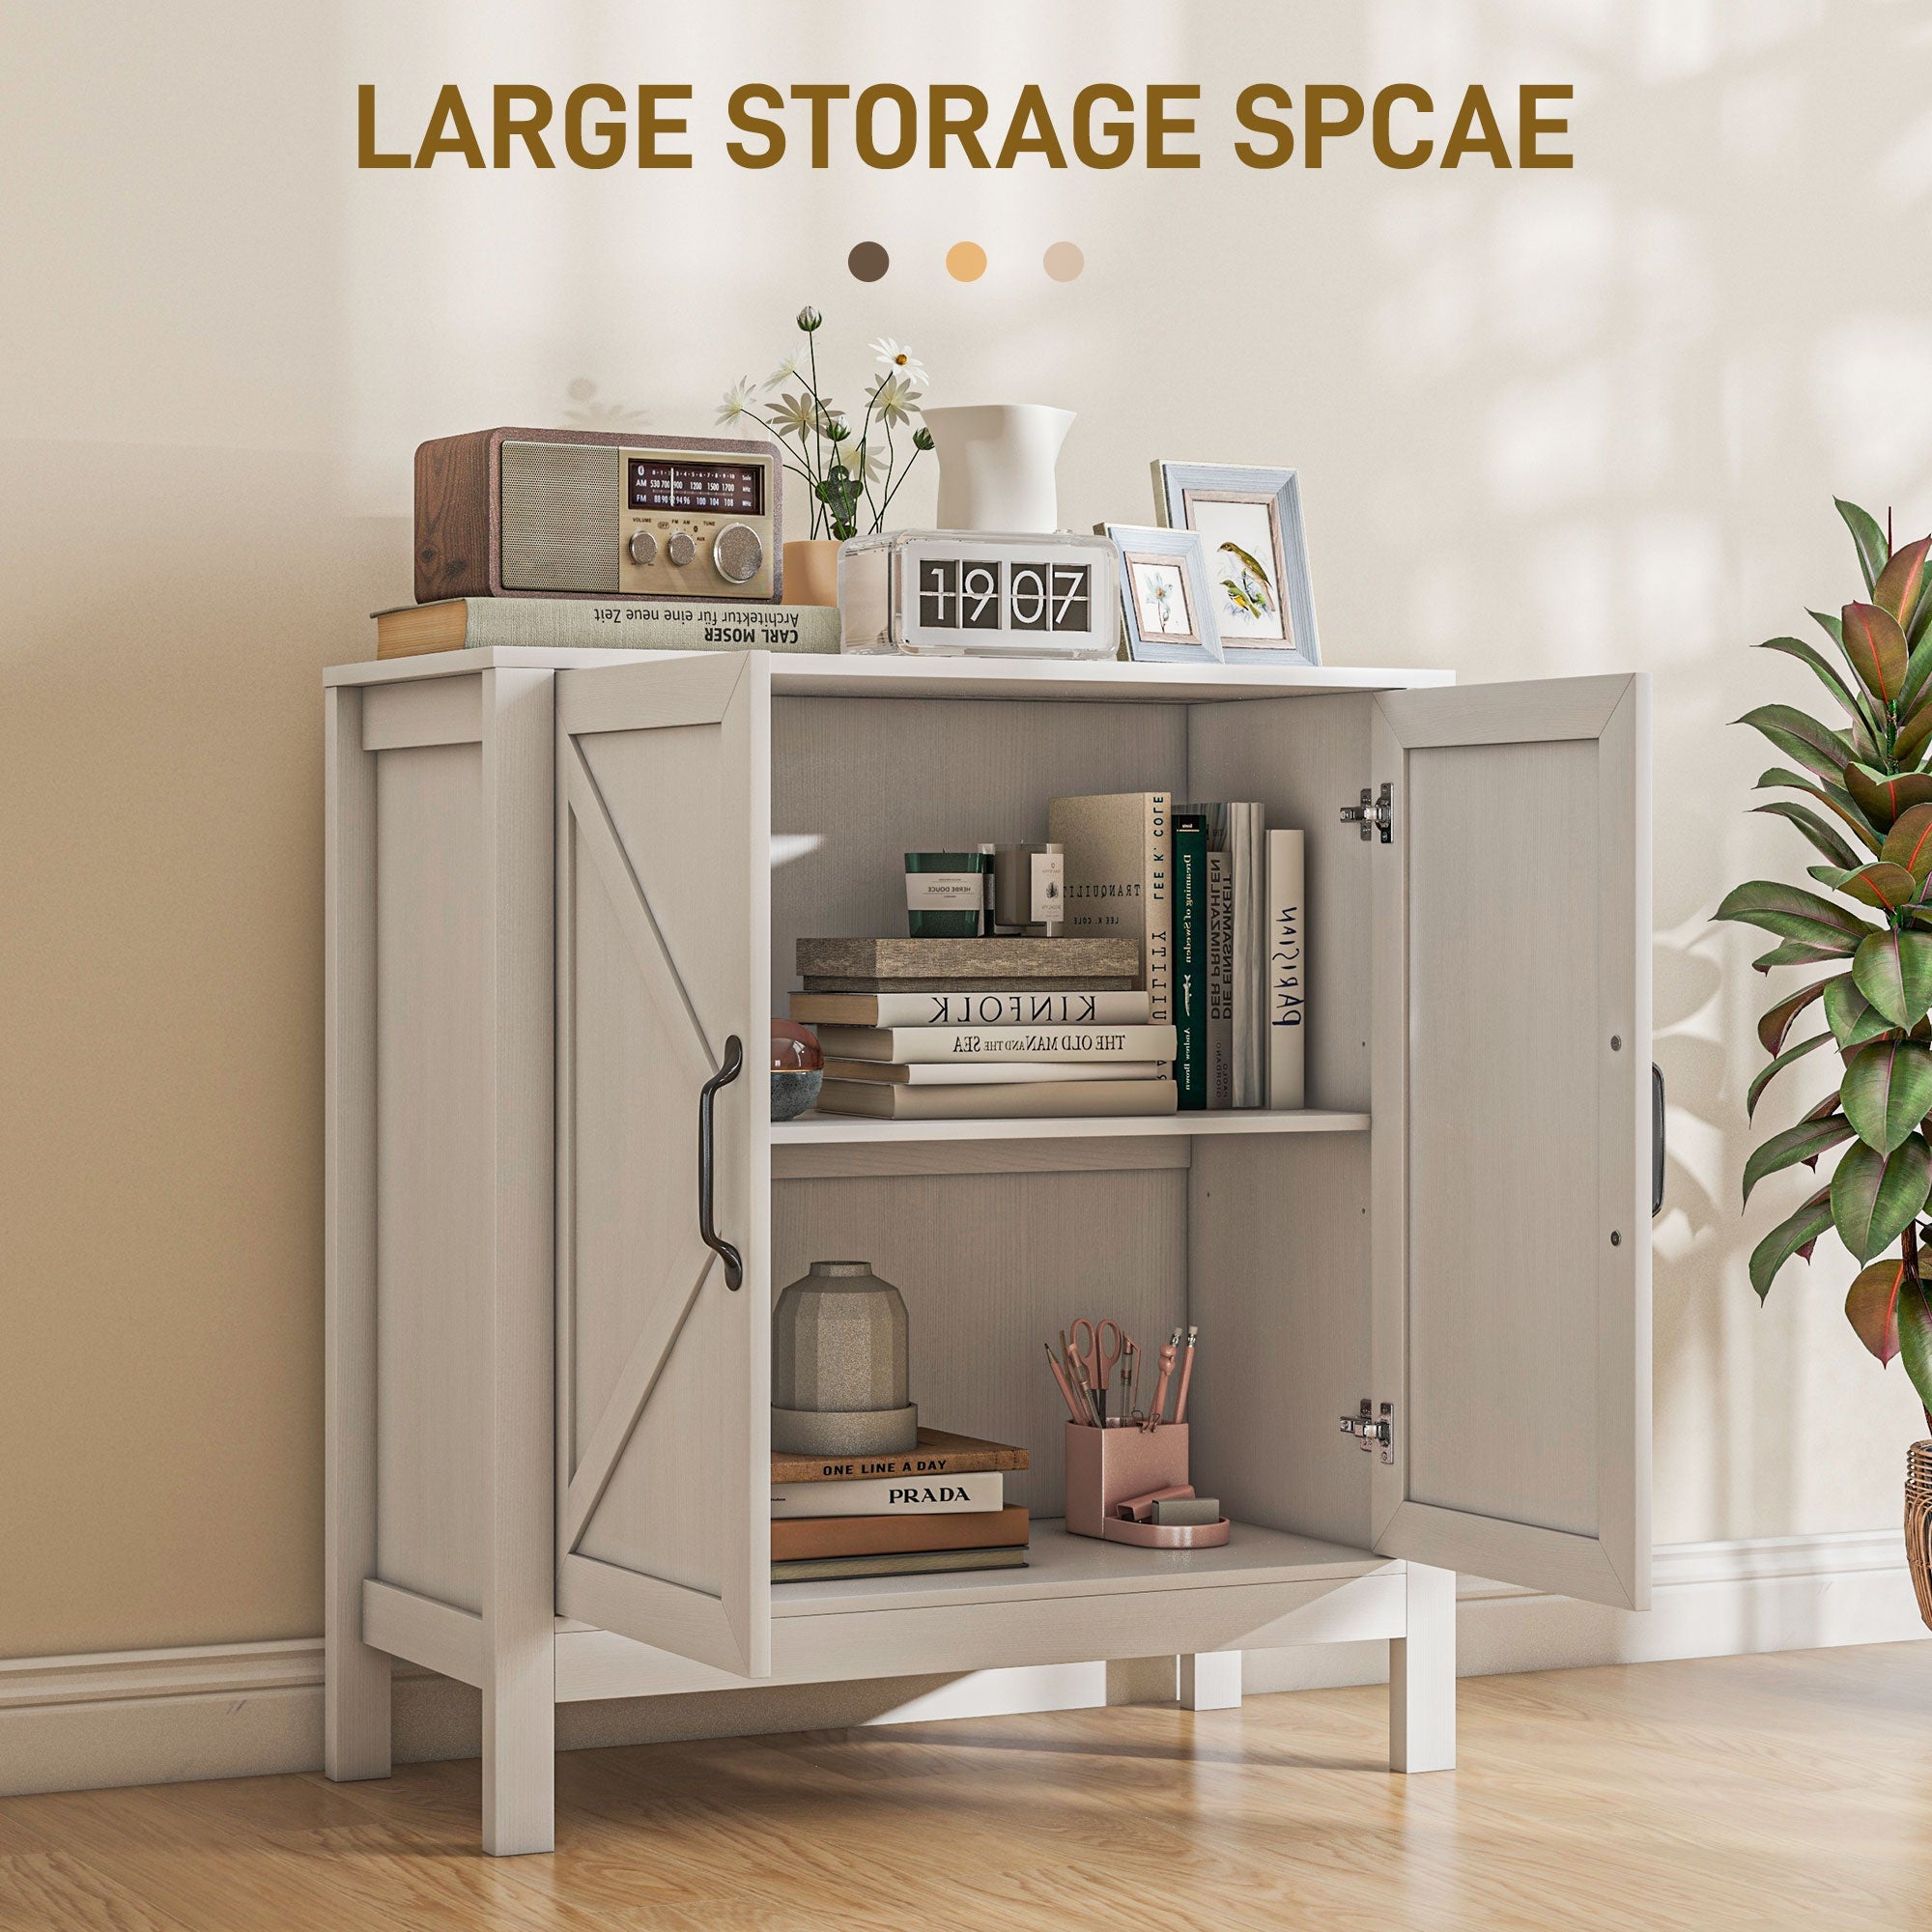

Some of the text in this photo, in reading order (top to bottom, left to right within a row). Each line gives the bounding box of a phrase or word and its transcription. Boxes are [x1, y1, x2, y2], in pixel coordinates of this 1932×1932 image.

[636, 478, 647, 487] AM
[650, 479, 661, 489] 530
[661, 480, 670, 489] 700
[690, 481, 702, 491] 1200
[707, 482, 720, 492] 1500
[722, 483, 735, 492] 1700
[636, 494, 647, 502] FM
[654, 495, 662, 503] 88
[676, 496, 683, 504] 94
[683, 496, 691, 505] 96
[696, 497, 707, 506] 100
[709, 497, 720, 506] 104
[724, 497, 734, 507] 108
[594, 609, 798, 627] Architektur für eine neue Zeit
[705, 628, 798, 643] CARL MOSER
[823, 1461, 947, 1475] ONE LINE A DAY
[890, 1488, 970, 1503] PRADA
